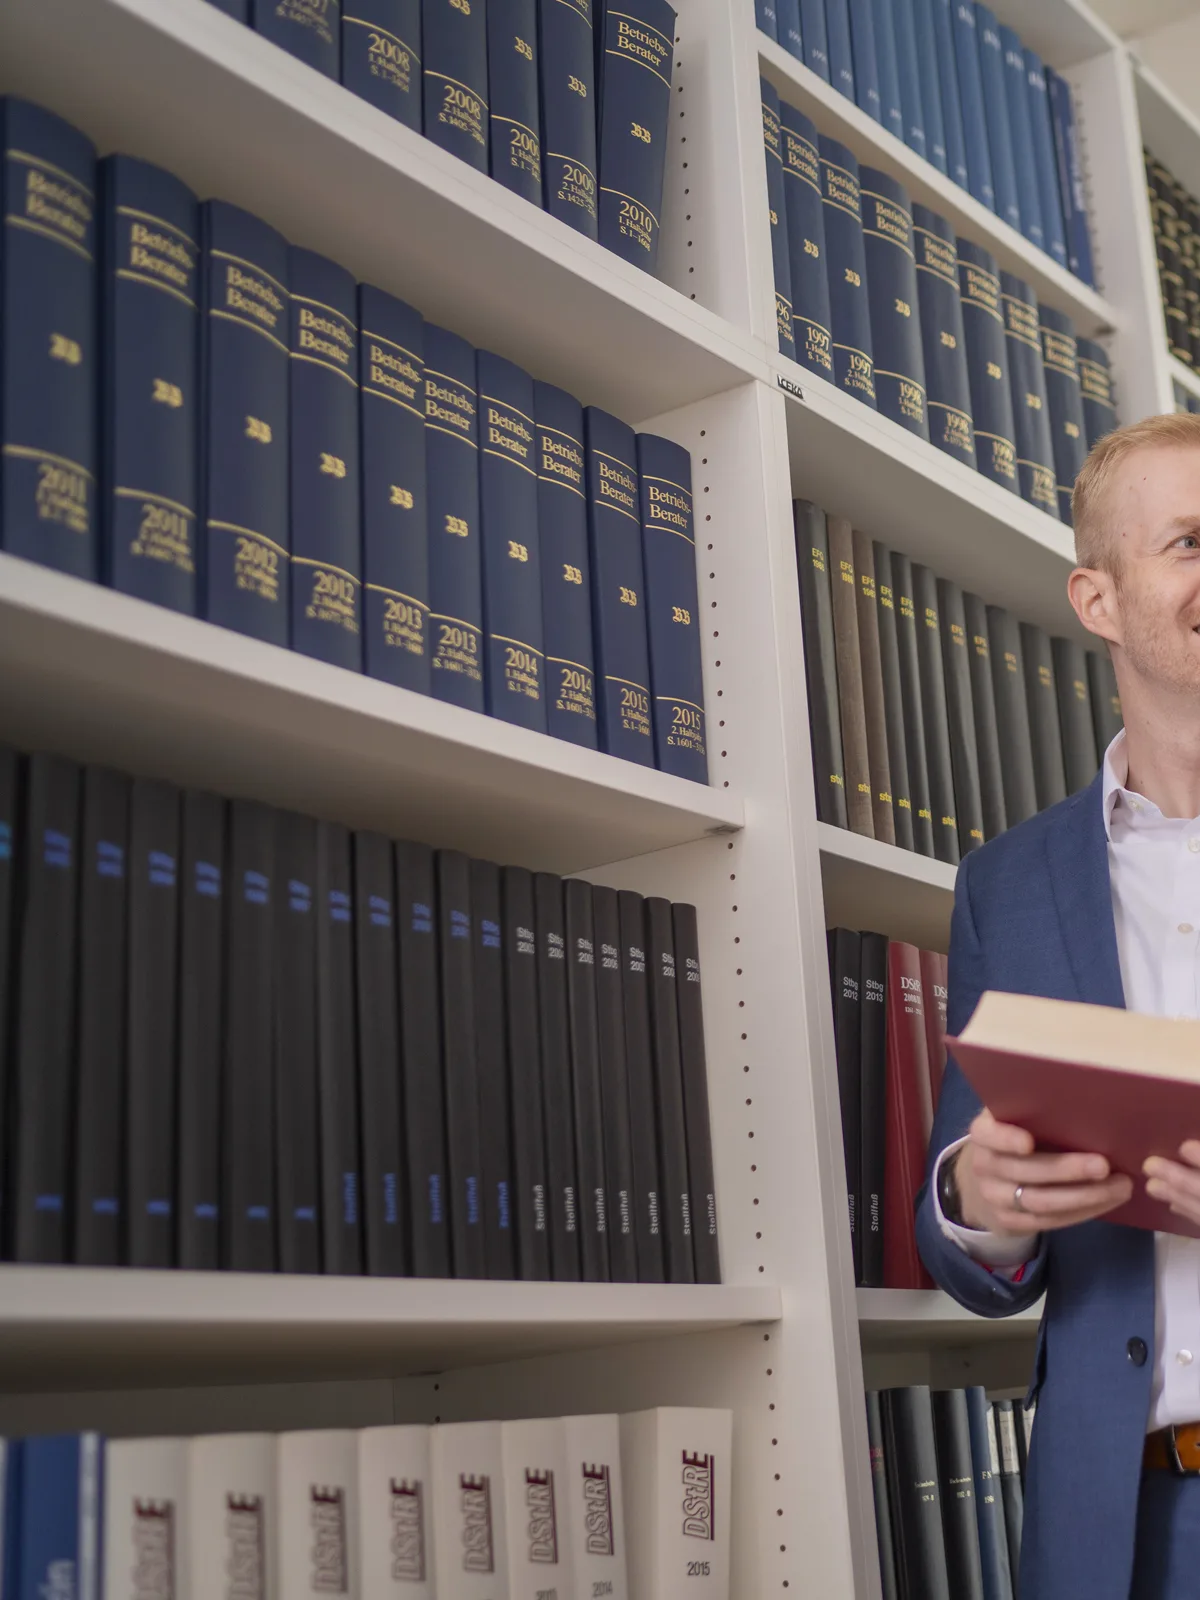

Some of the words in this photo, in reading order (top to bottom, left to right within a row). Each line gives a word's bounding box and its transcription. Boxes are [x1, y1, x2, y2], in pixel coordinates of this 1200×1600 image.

[368, 33, 410, 71] 2008
[617, 35, 661, 67] Berater
[618, 21, 668, 56] Betriebs-
[444, 85, 481, 120] 2008
[563, 164, 595, 194] 2009
[619, 201, 652, 233] 2010
[806, 327, 830, 351] 1997
[850, 354, 871, 378] 1997
[371, 365, 416, 400] Berater
[425, 380, 476, 415] Betriebs-
[425, 399, 471, 431] Berater
[488, 408, 534, 443] Betriebs-
[489, 427, 528, 458] Berater
[542, 436, 584, 468] Betriebs-
[542, 454, 582, 484] Berater
[599, 461, 637, 493] Betriebs-
[600, 479, 635, 509] Berater
[649, 486, 692, 514] Betriebs-
[649, 503, 688, 529] Berater
[384, 598, 422, 630] 2013
[439, 624, 477, 653] 2013
[505, 647, 538, 675] 2014
[561, 668, 592, 695] 2014
[621, 688, 648, 713] 2015
[672, 706, 700, 730] 2015
[601, 943, 618, 958] Stbg
[629, 946, 645, 962] Stbg
[630, 961, 645, 973] 2007
[843, 976, 858, 990] Stbg
[843, 989, 858, 1001] 2012
[866, 979, 884, 993] Stbg
[866, 991, 883, 1002] 2013
[564, 1186, 576, 1233] Stollfuß
[594, 1187, 606, 1232] Stollfuß
[619, 1190, 630, 1235] Stollfuß
[648, 1191, 659, 1235] Stollfuß
[681, 1193, 691, 1236] Stollfuß
[706, 1193, 716, 1235] Stollfuß
[871, 1193, 879, 1232] Stollfuß
[582, 1461, 611, 1556] DStRE
[682, 1449, 710, 1540] DStRE
[525, 1467, 554, 1563] DStRE
[687, 1561, 710, 1577] 2015
[592, 1580, 613, 1598] 2014
